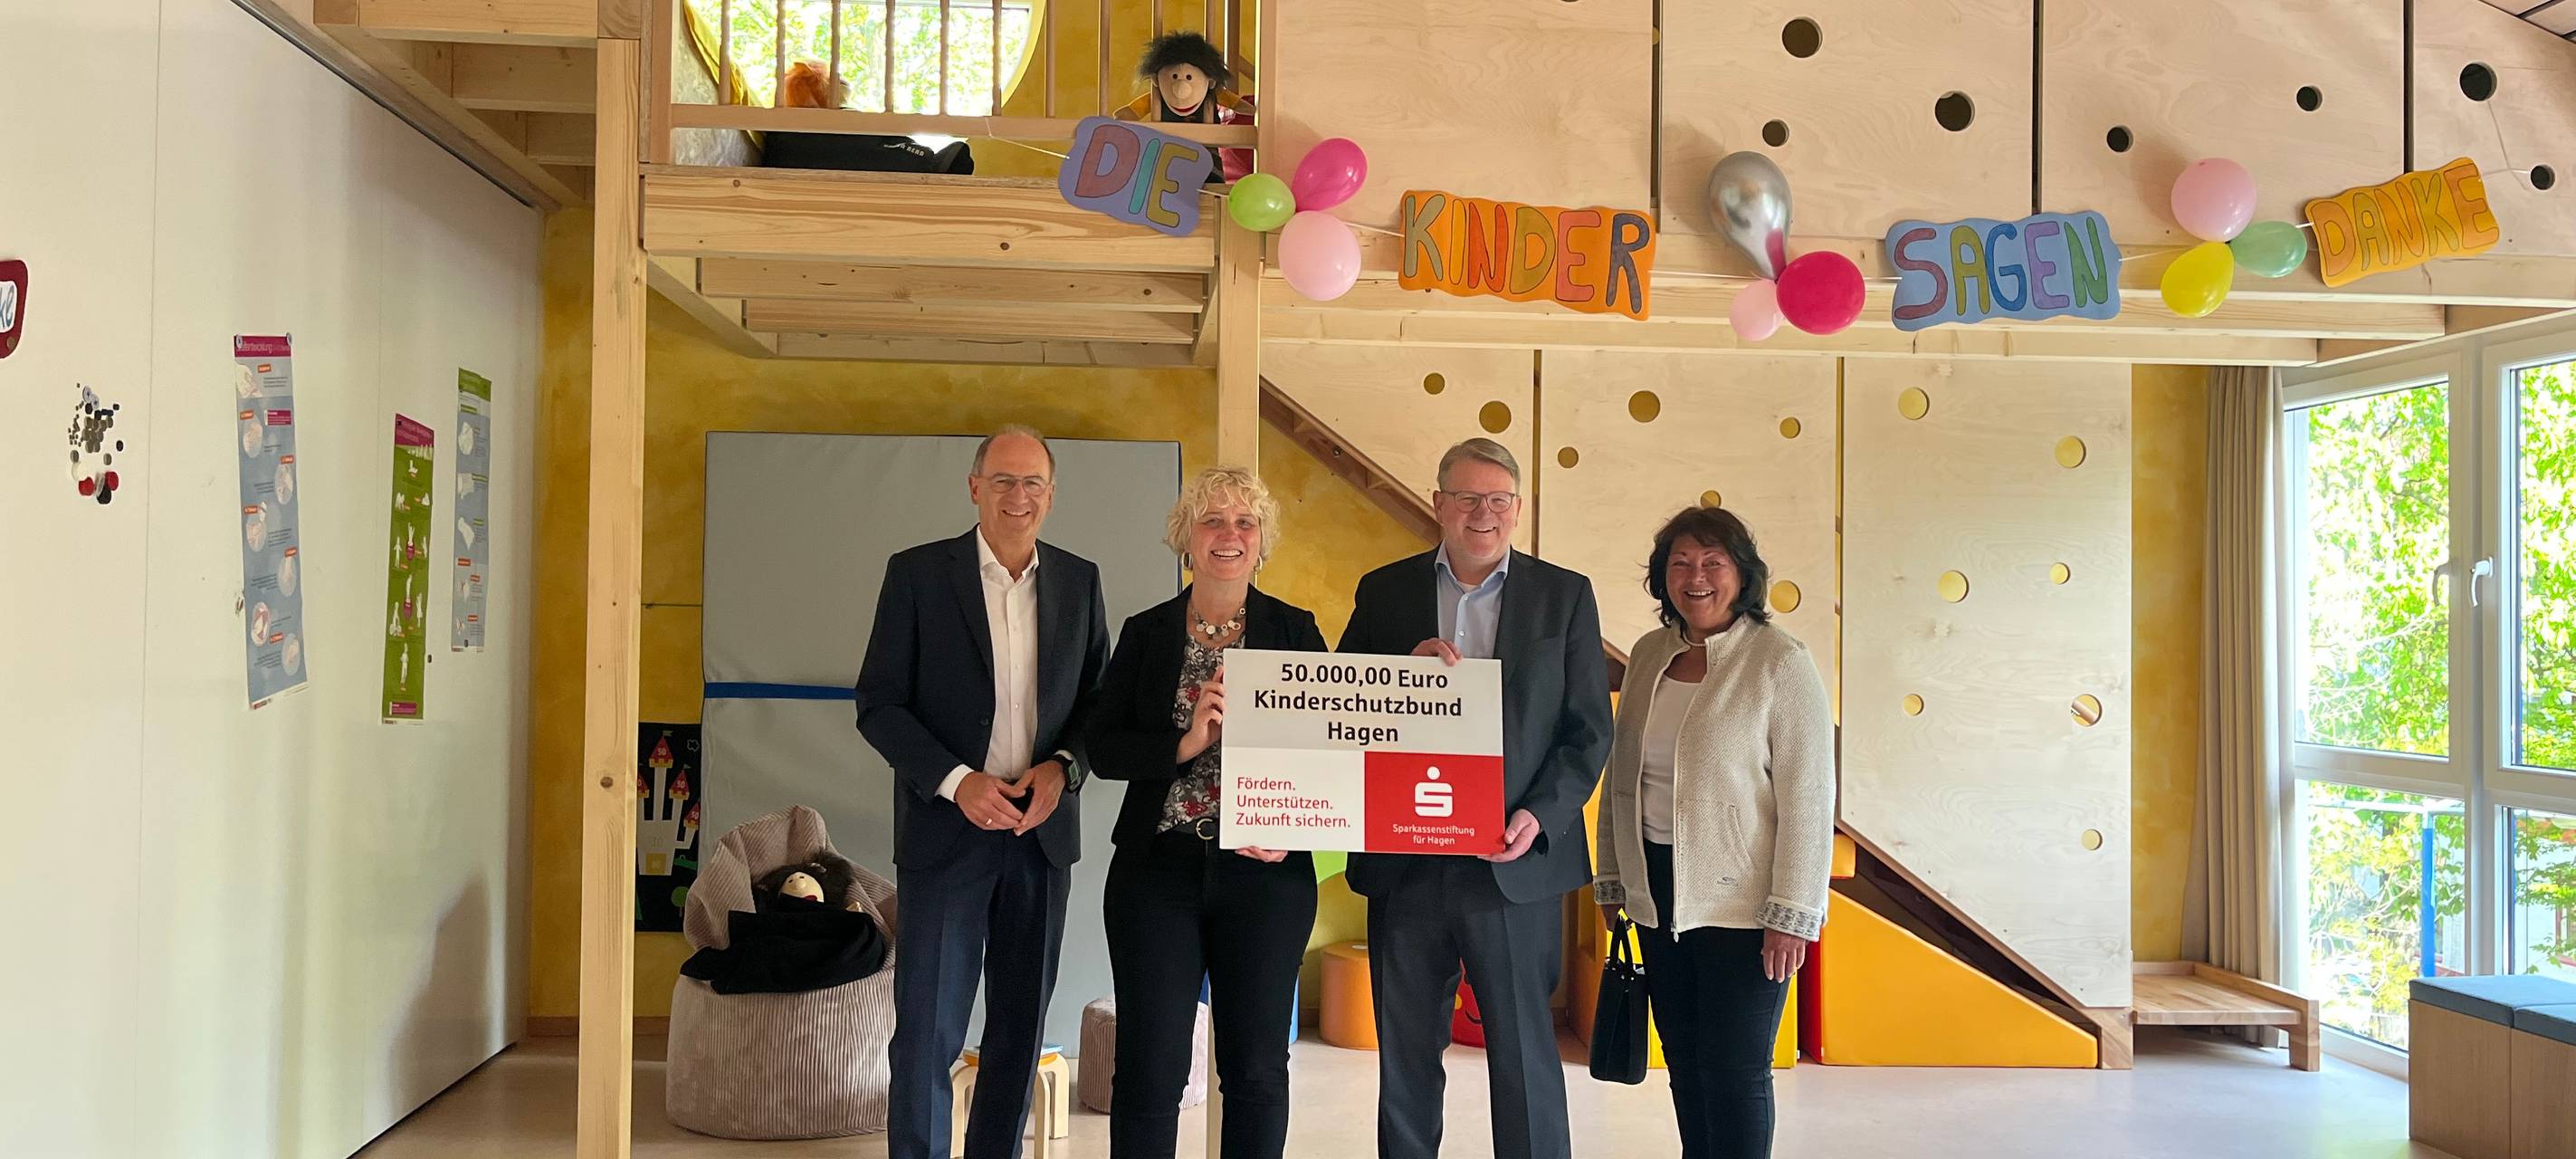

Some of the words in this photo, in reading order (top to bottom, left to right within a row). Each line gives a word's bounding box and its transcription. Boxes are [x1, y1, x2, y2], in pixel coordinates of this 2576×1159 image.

[1074, 124, 1199, 228] DIE
[1403, 194, 1650, 313] KINDER
[1894, 216, 2109, 320] SAGEN
[2310, 162, 2500, 277] DANKE
[1281, 664, 1391, 687] 50.000,00
[1398, 670, 1448, 688] Euro
[1255, 690, 1462, 716] Kinderschutzbund
[1328, 722, 1398, 745] Hagen
[1236, 776, 1296, 790] Fördern.
[1236, 795, 1333, 809] Unterstützen.
[1236, 812, 1291, 826] Zukunft
[1295, 813, 1350, 828] sichern.
[1392, 823, 1475, 837] Sparkassenstiftung
[1413, 835, 1426, 844] für
[1427, 836, 1455, 847] Hagen
